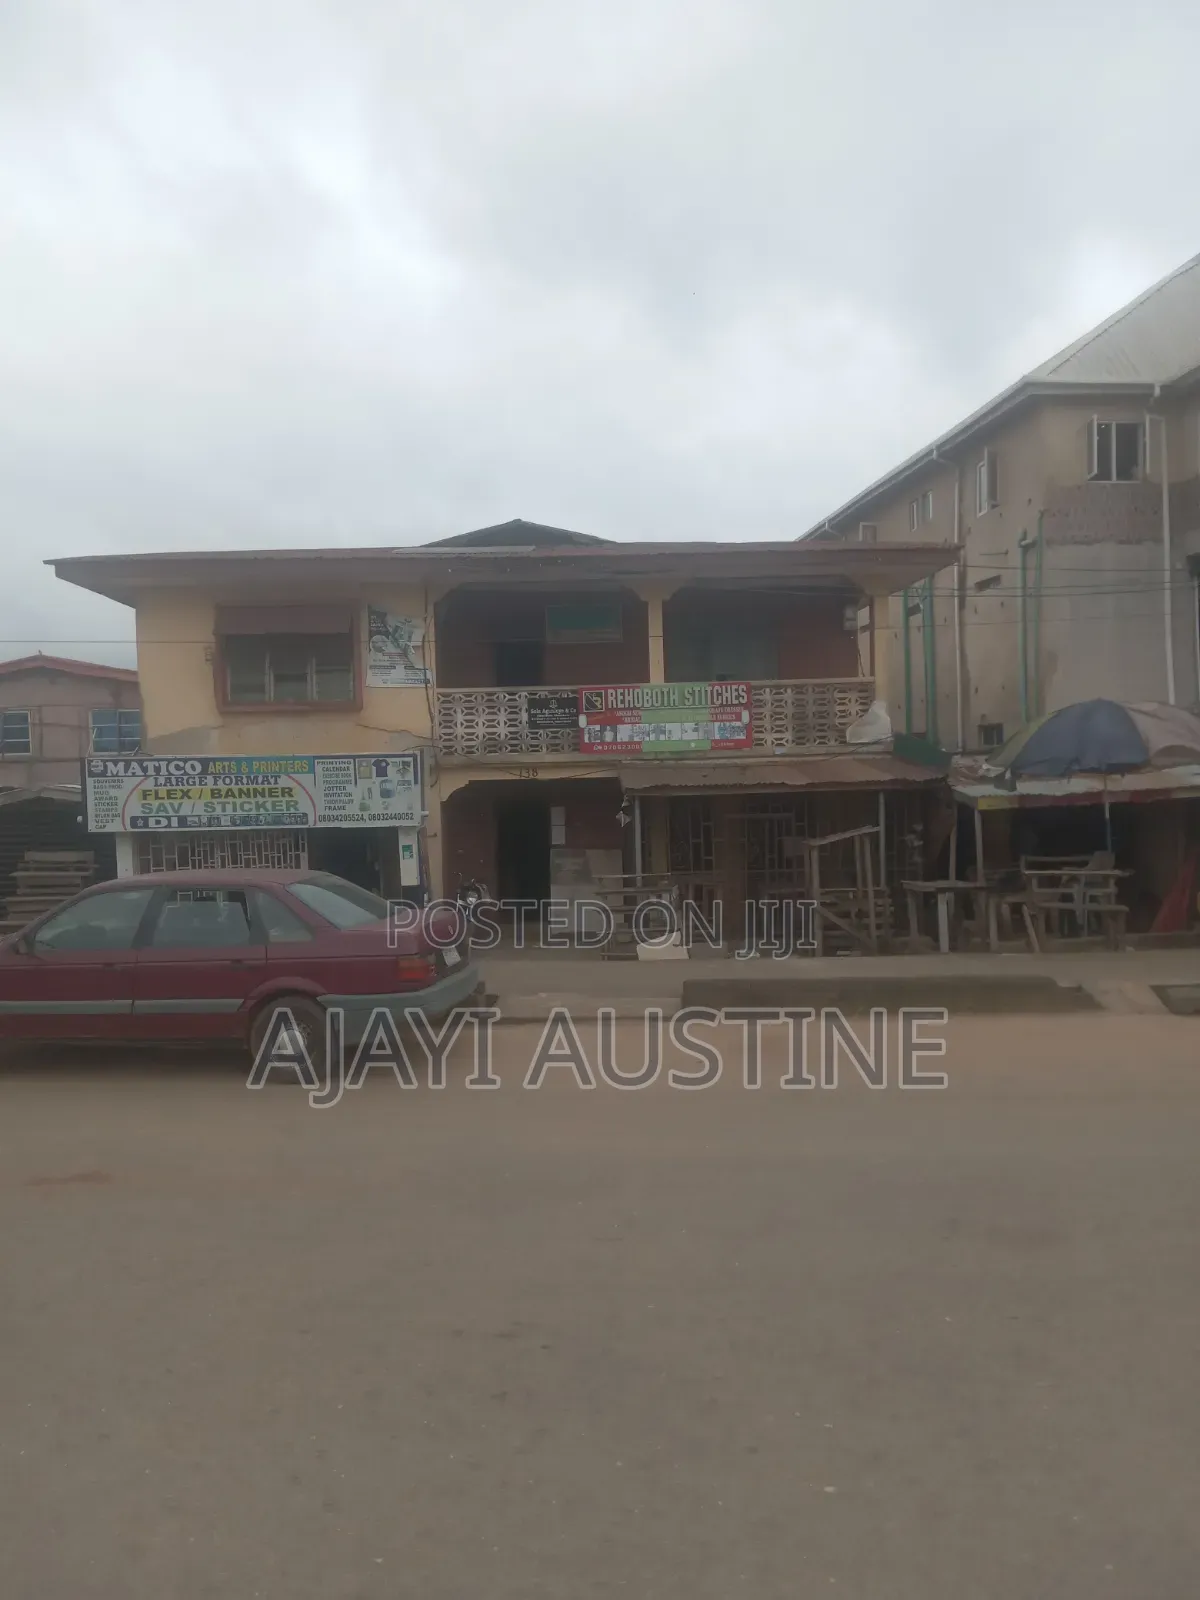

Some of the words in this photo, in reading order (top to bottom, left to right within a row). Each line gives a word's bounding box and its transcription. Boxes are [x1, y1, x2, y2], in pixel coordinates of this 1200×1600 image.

[607, 687, 679, 708] REHOBOTH
[684, 684, 748, 706] STITCHES
[105, 760, 202, 776] MATICO
[208, 761, 237, 774] ARTS
[241, 761, 249, 773] &
[253, 759, 309, 773] PRINTERS
[153, 776, 208, 787] LARGE
[212, 774, 281, 786] FORMAT
[141, 788, 193, 800] FLEX
[198, 788, 204, 799] /
[210, 787, 294, 799] BANNER
[141, 801, 183, 815] SAV
[190, 801, 196, 814] /
[203, 800, 300, 813] STICKER
[318, 813, 366, 823] 08034205524,
[368, 812, 414, 821] 08032440052
